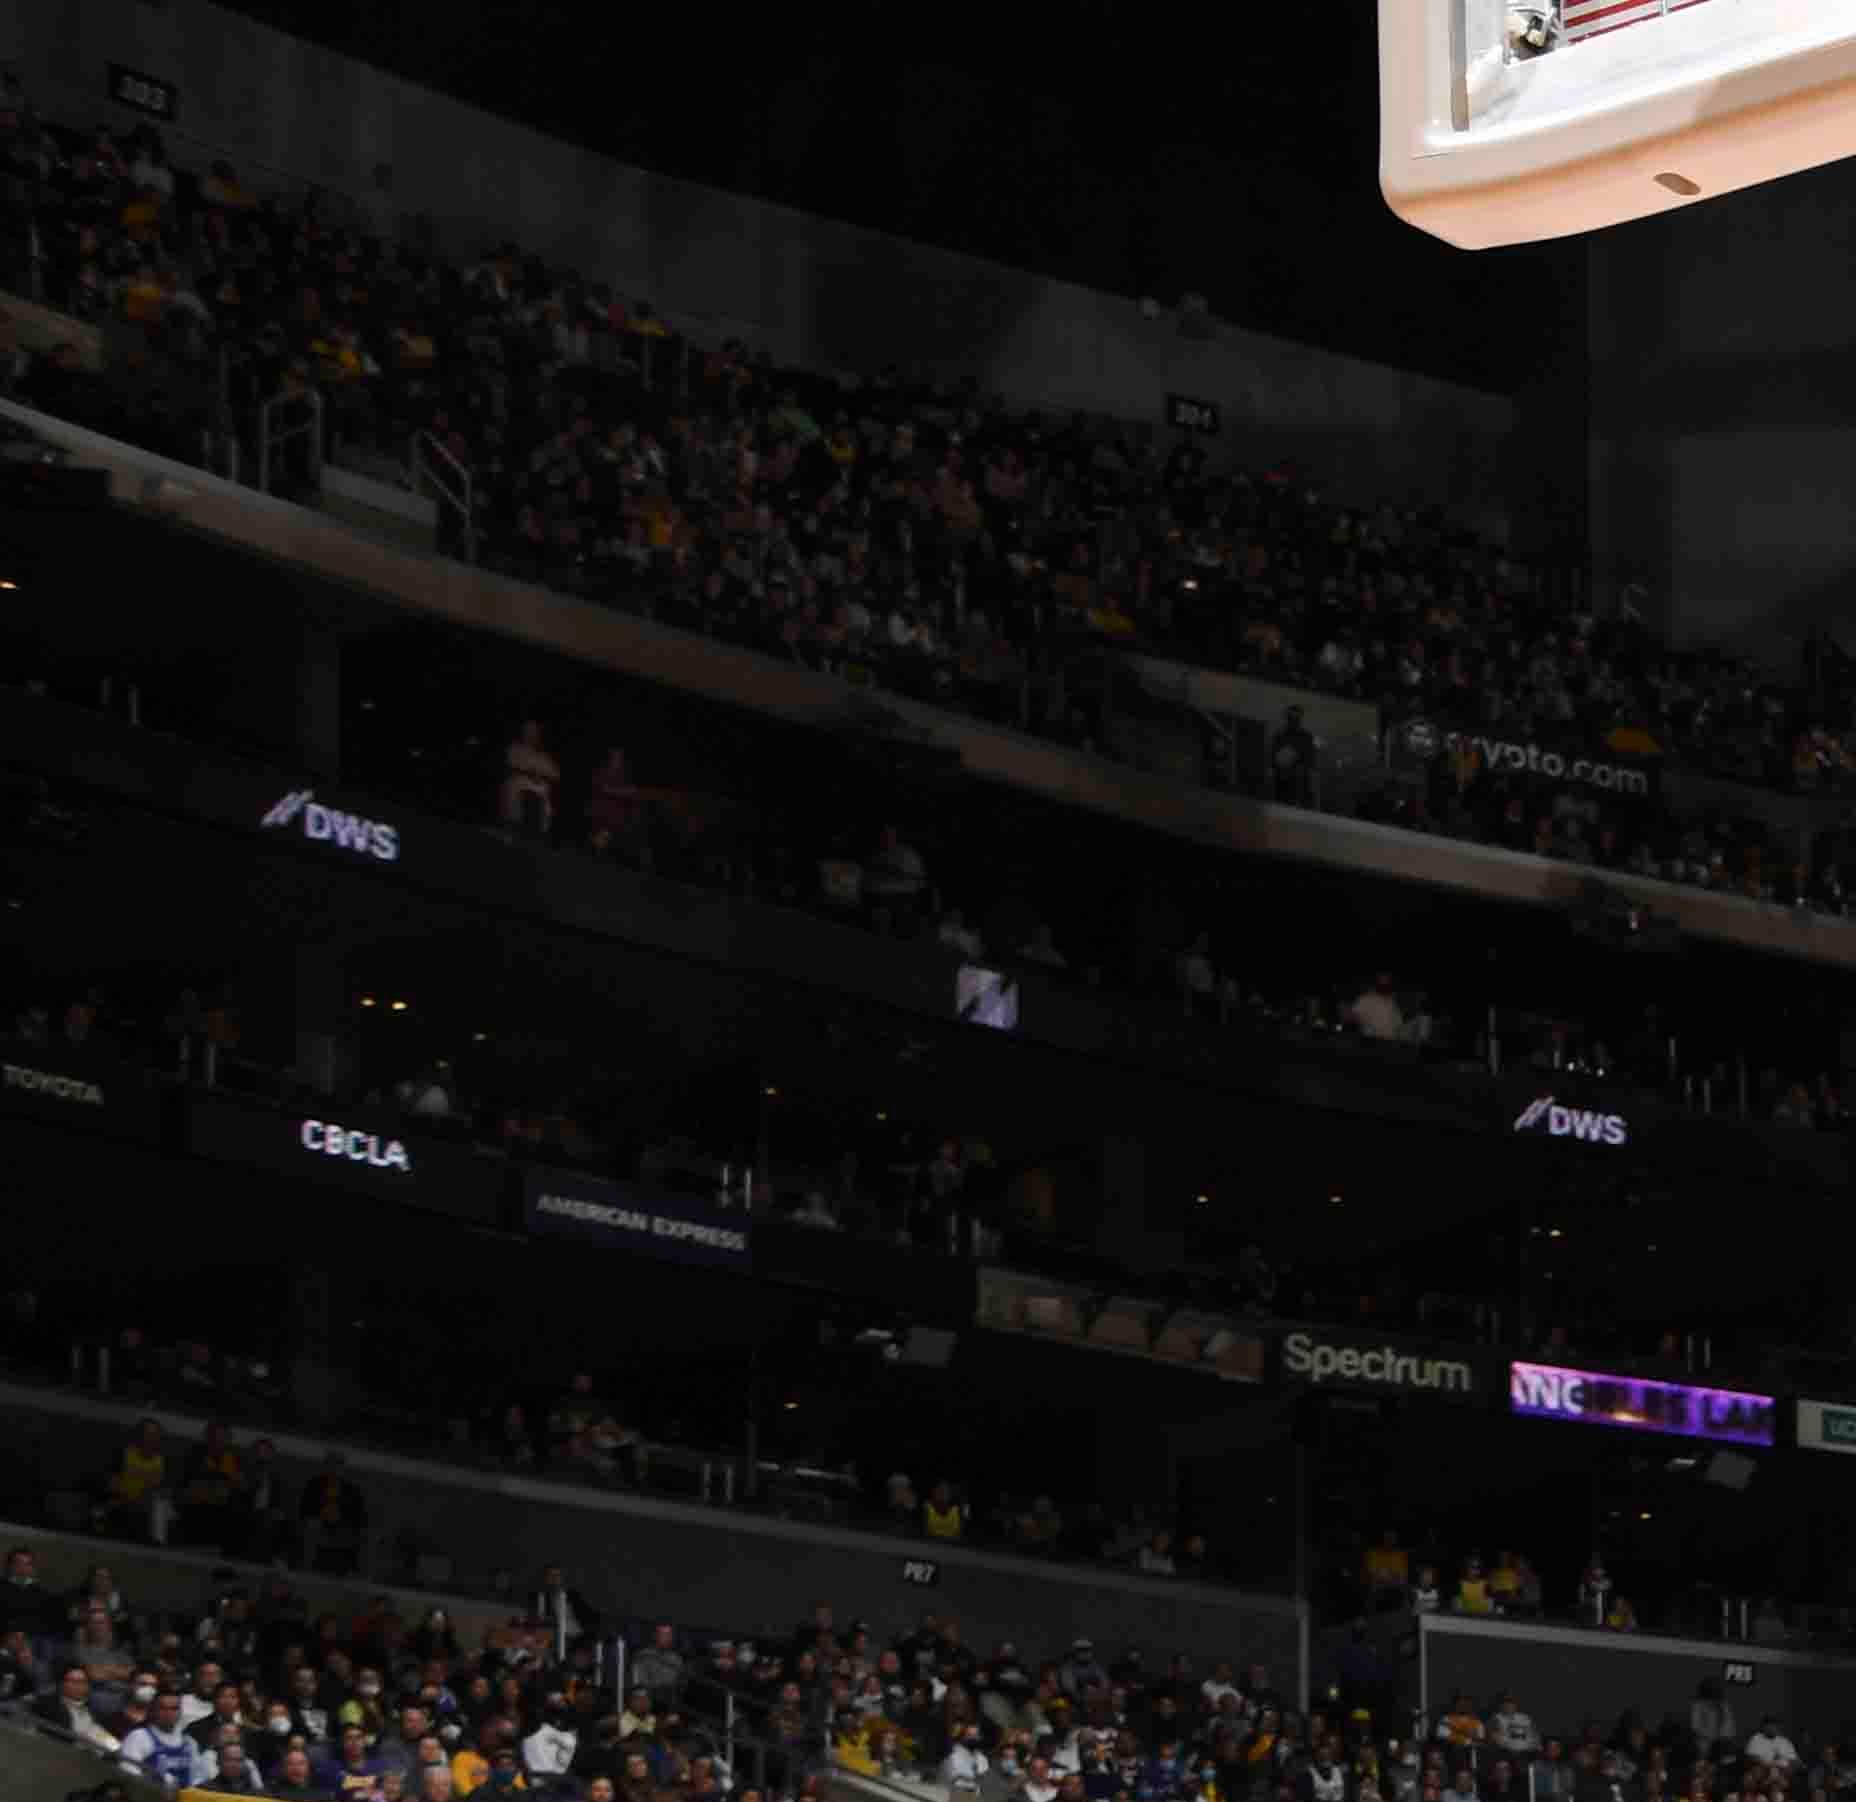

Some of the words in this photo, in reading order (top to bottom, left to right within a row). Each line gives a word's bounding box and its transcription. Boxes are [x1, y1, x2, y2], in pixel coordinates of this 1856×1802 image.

[304, 802, 400, 862] DWS
[301, 1118, 412, 1174] CBCLA
[1548, 1104, 1629, 1145] DWS
[1282, 1328, 1474, 1393] Spectrum
